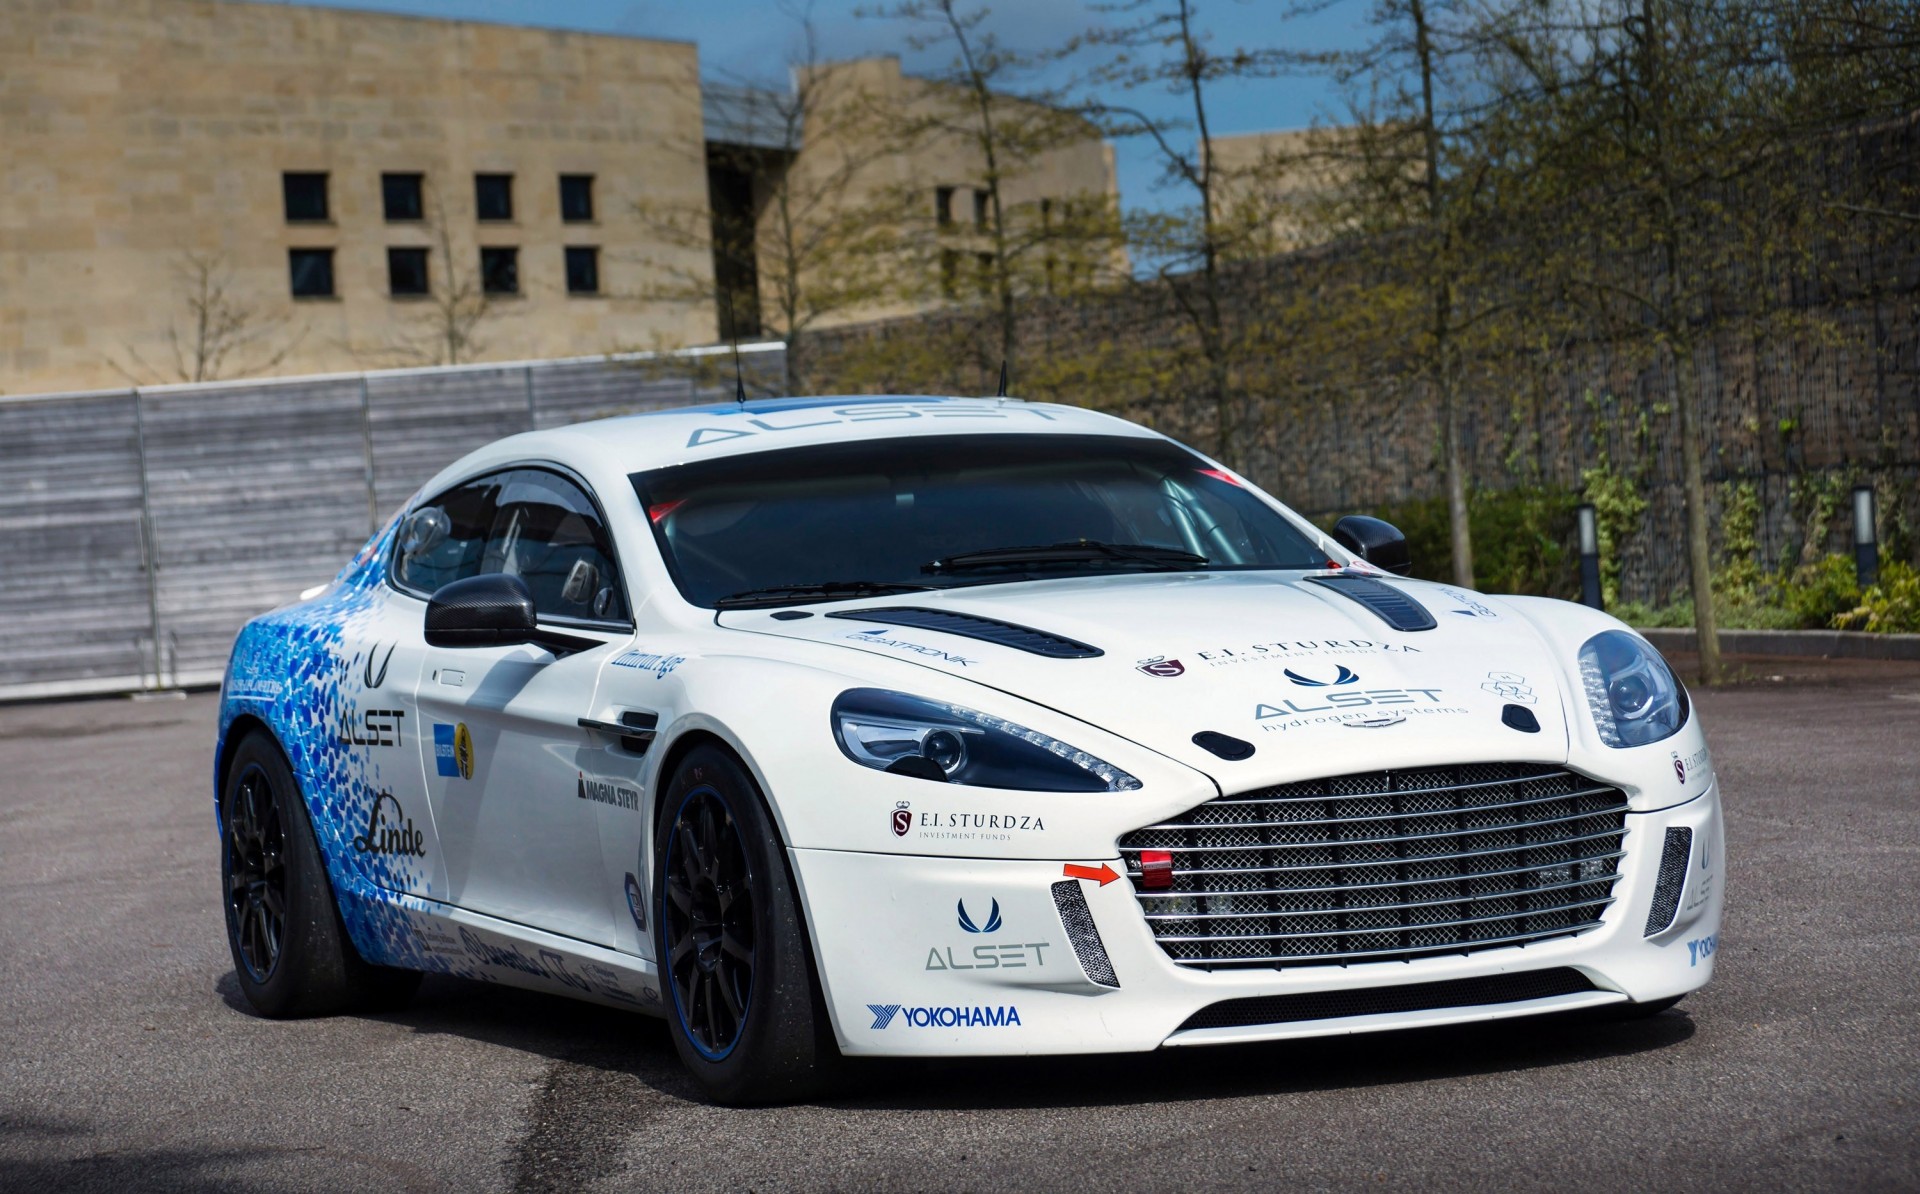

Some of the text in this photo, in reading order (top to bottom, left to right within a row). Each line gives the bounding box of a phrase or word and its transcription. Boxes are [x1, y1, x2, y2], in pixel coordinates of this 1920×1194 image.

[686, 404, 1064, 448] ALSET
[1251, 639, 1423, 655] STURDZA
[1255, 688, 1443, 720] ALSET
[338, 710, 405, 748] ALSET
[1261, 706, 1469, 732] hydrogen systems
[586, 780, 639, 812] MAGNA STEYR
[353, 789, 426, 857] Linde
[949, 812, 1045, 831] STURDZA
[919, 831, 1011, 841] INVESTMENT FUNDS
[925, 943, 1050, 971] ALSET
[902, 1005, 1021, 1028] YOKOHAMA
